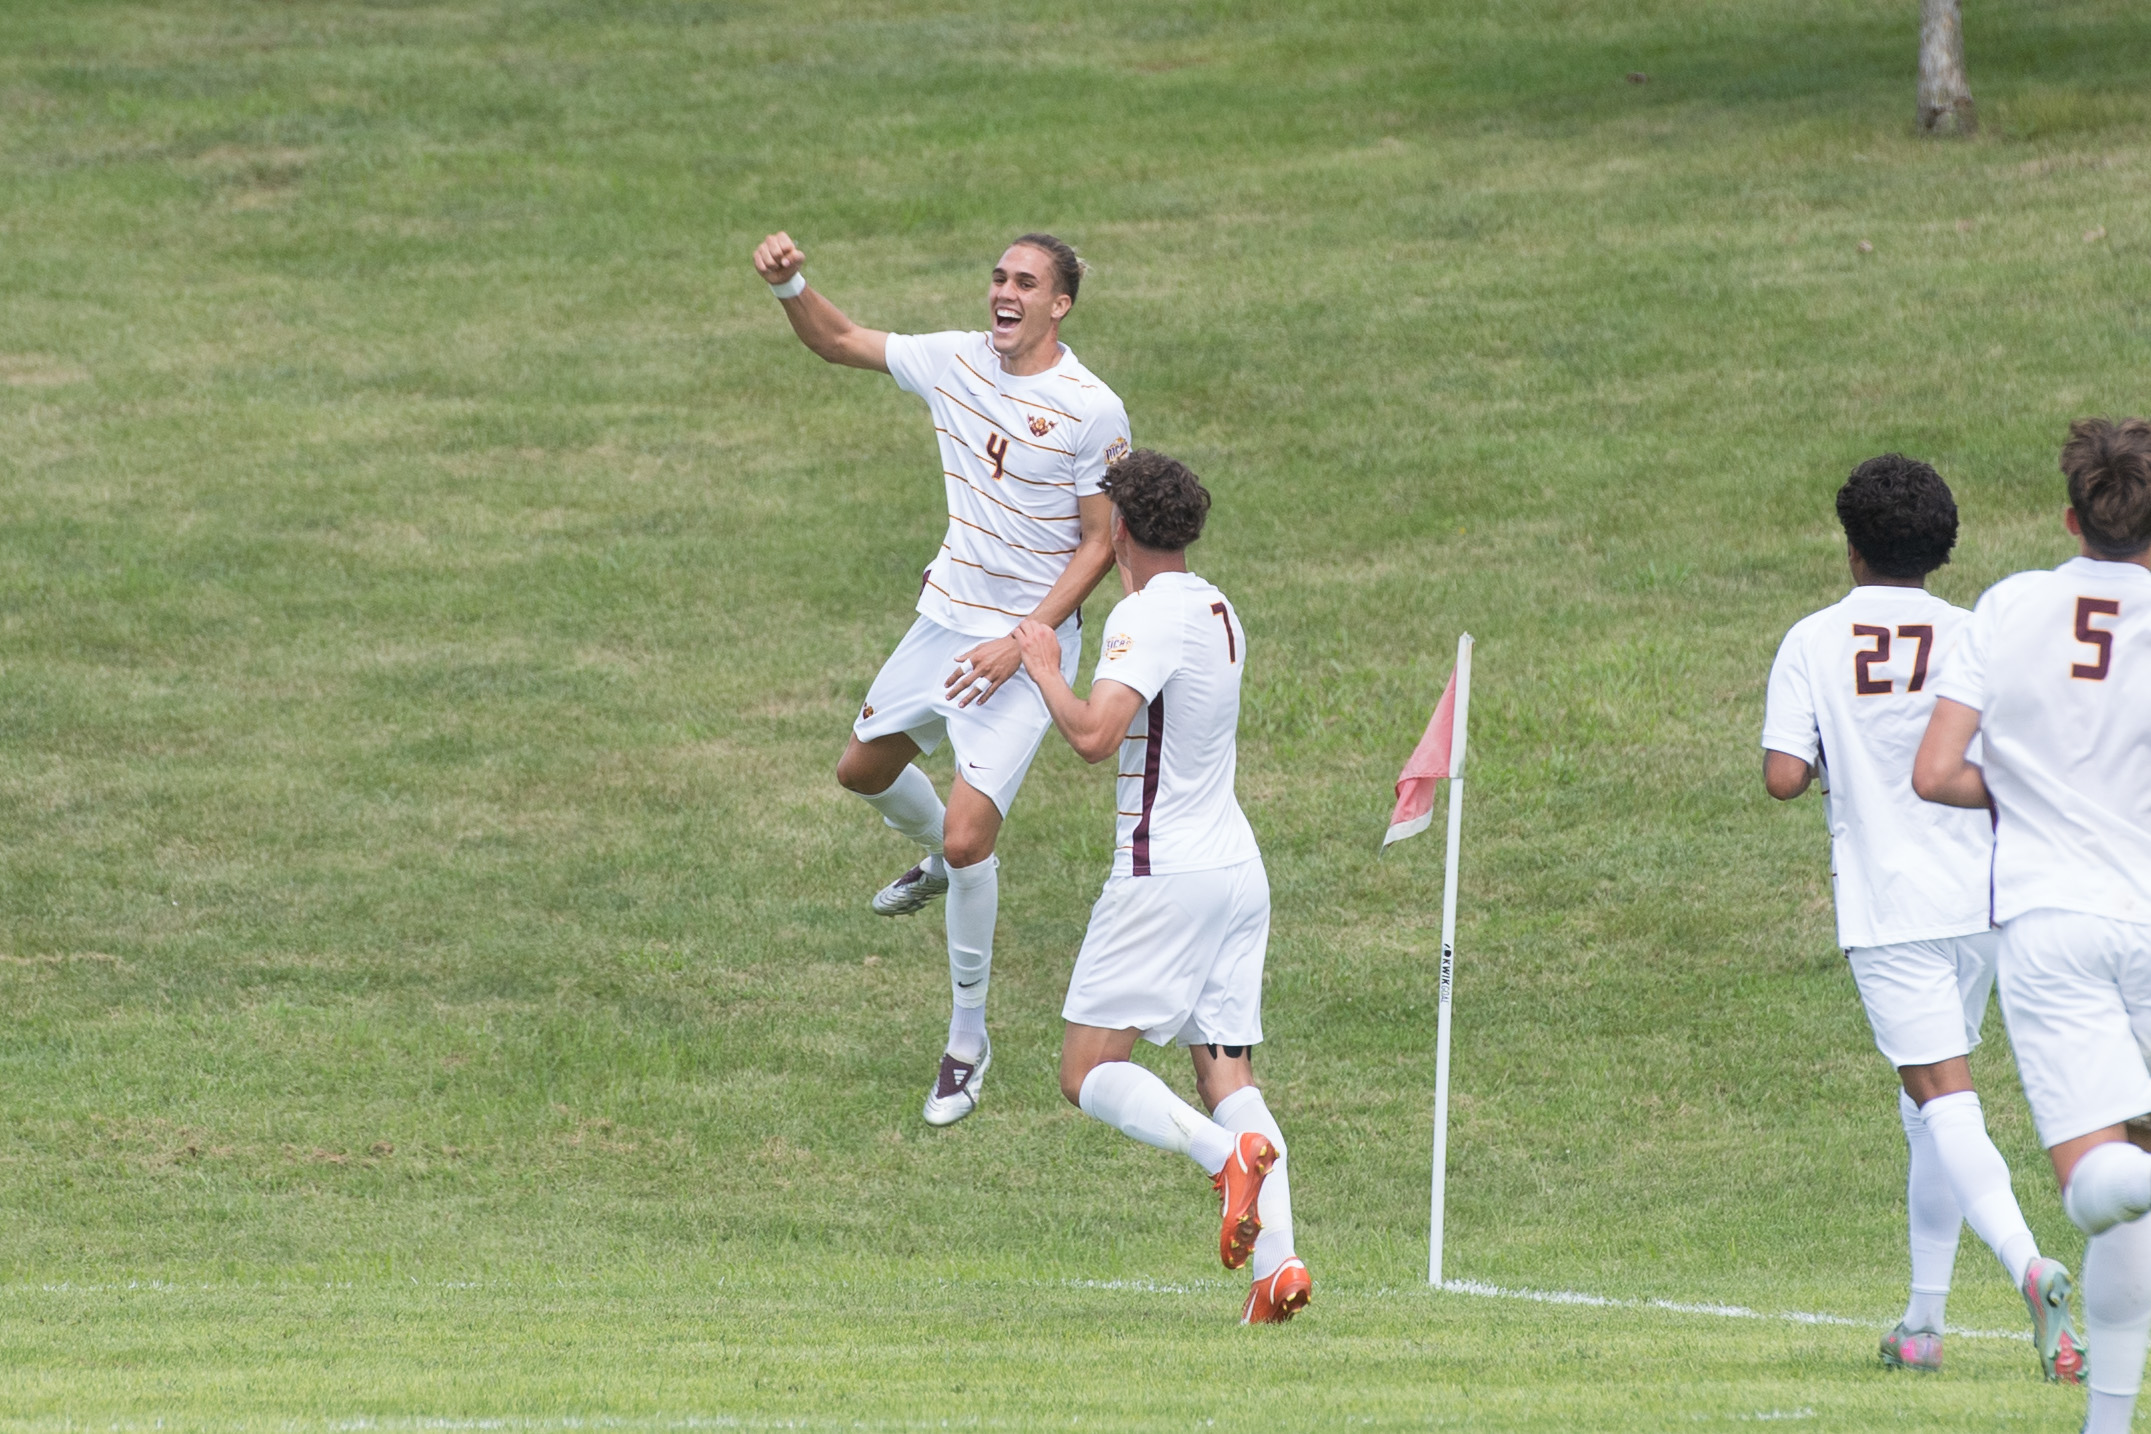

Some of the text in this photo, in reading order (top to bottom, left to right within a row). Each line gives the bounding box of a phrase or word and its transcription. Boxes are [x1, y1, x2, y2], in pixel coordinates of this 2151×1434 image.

[986, 432, 1010, 480] 4
[1210, 600, 1236, 664] 7
[1853, 623, 1933, 696] 27
[2070, 596, 2120, 680] 5
